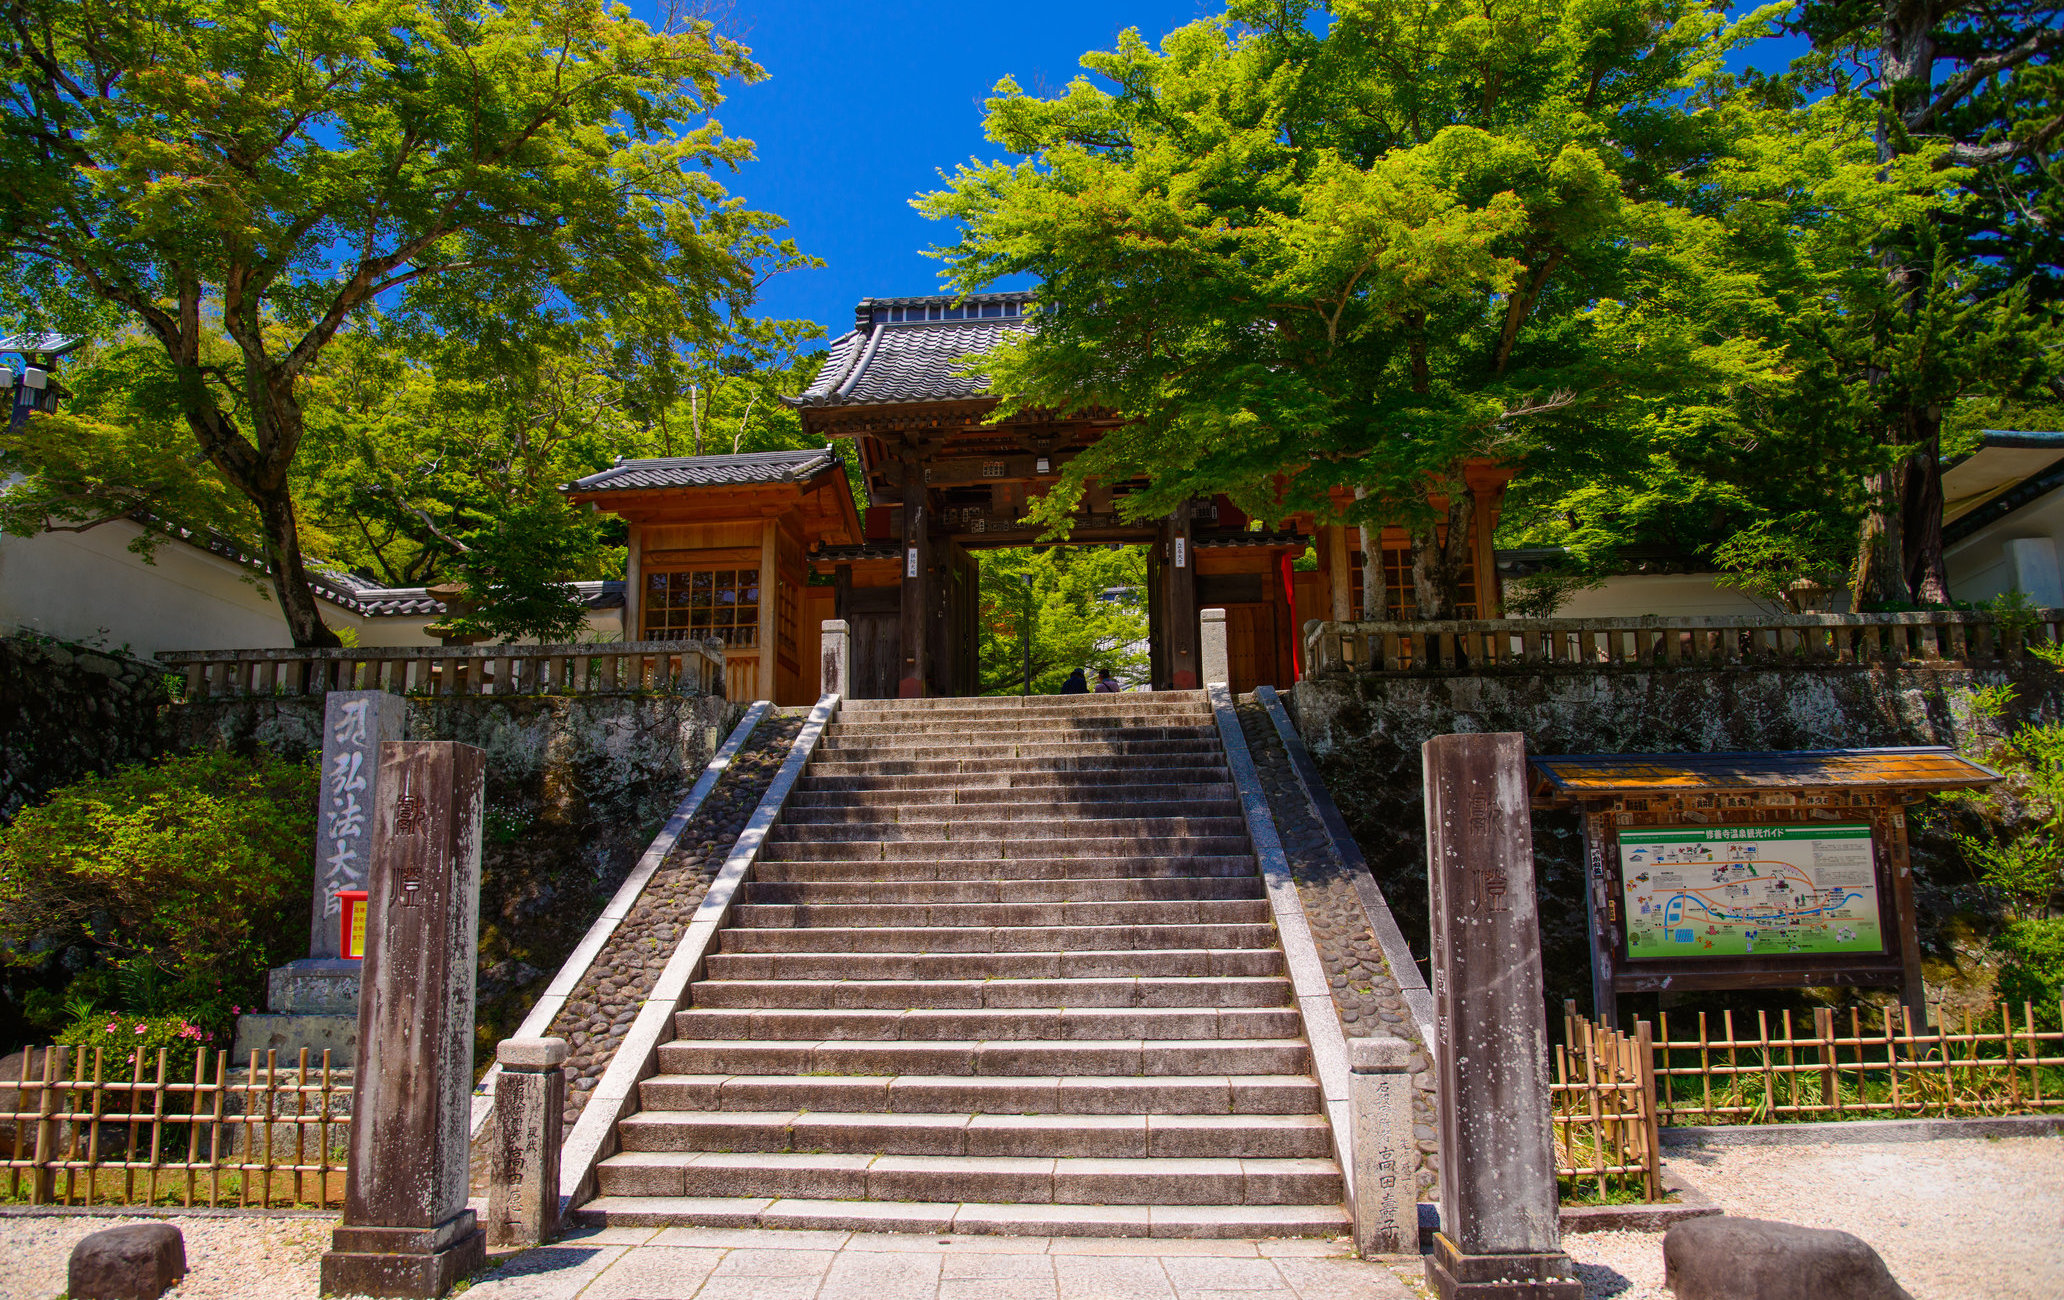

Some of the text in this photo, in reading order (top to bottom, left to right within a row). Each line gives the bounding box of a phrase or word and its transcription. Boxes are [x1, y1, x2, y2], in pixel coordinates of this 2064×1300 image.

[1706, 828, 1784, 839] 修善寺温泉観光ガイド
